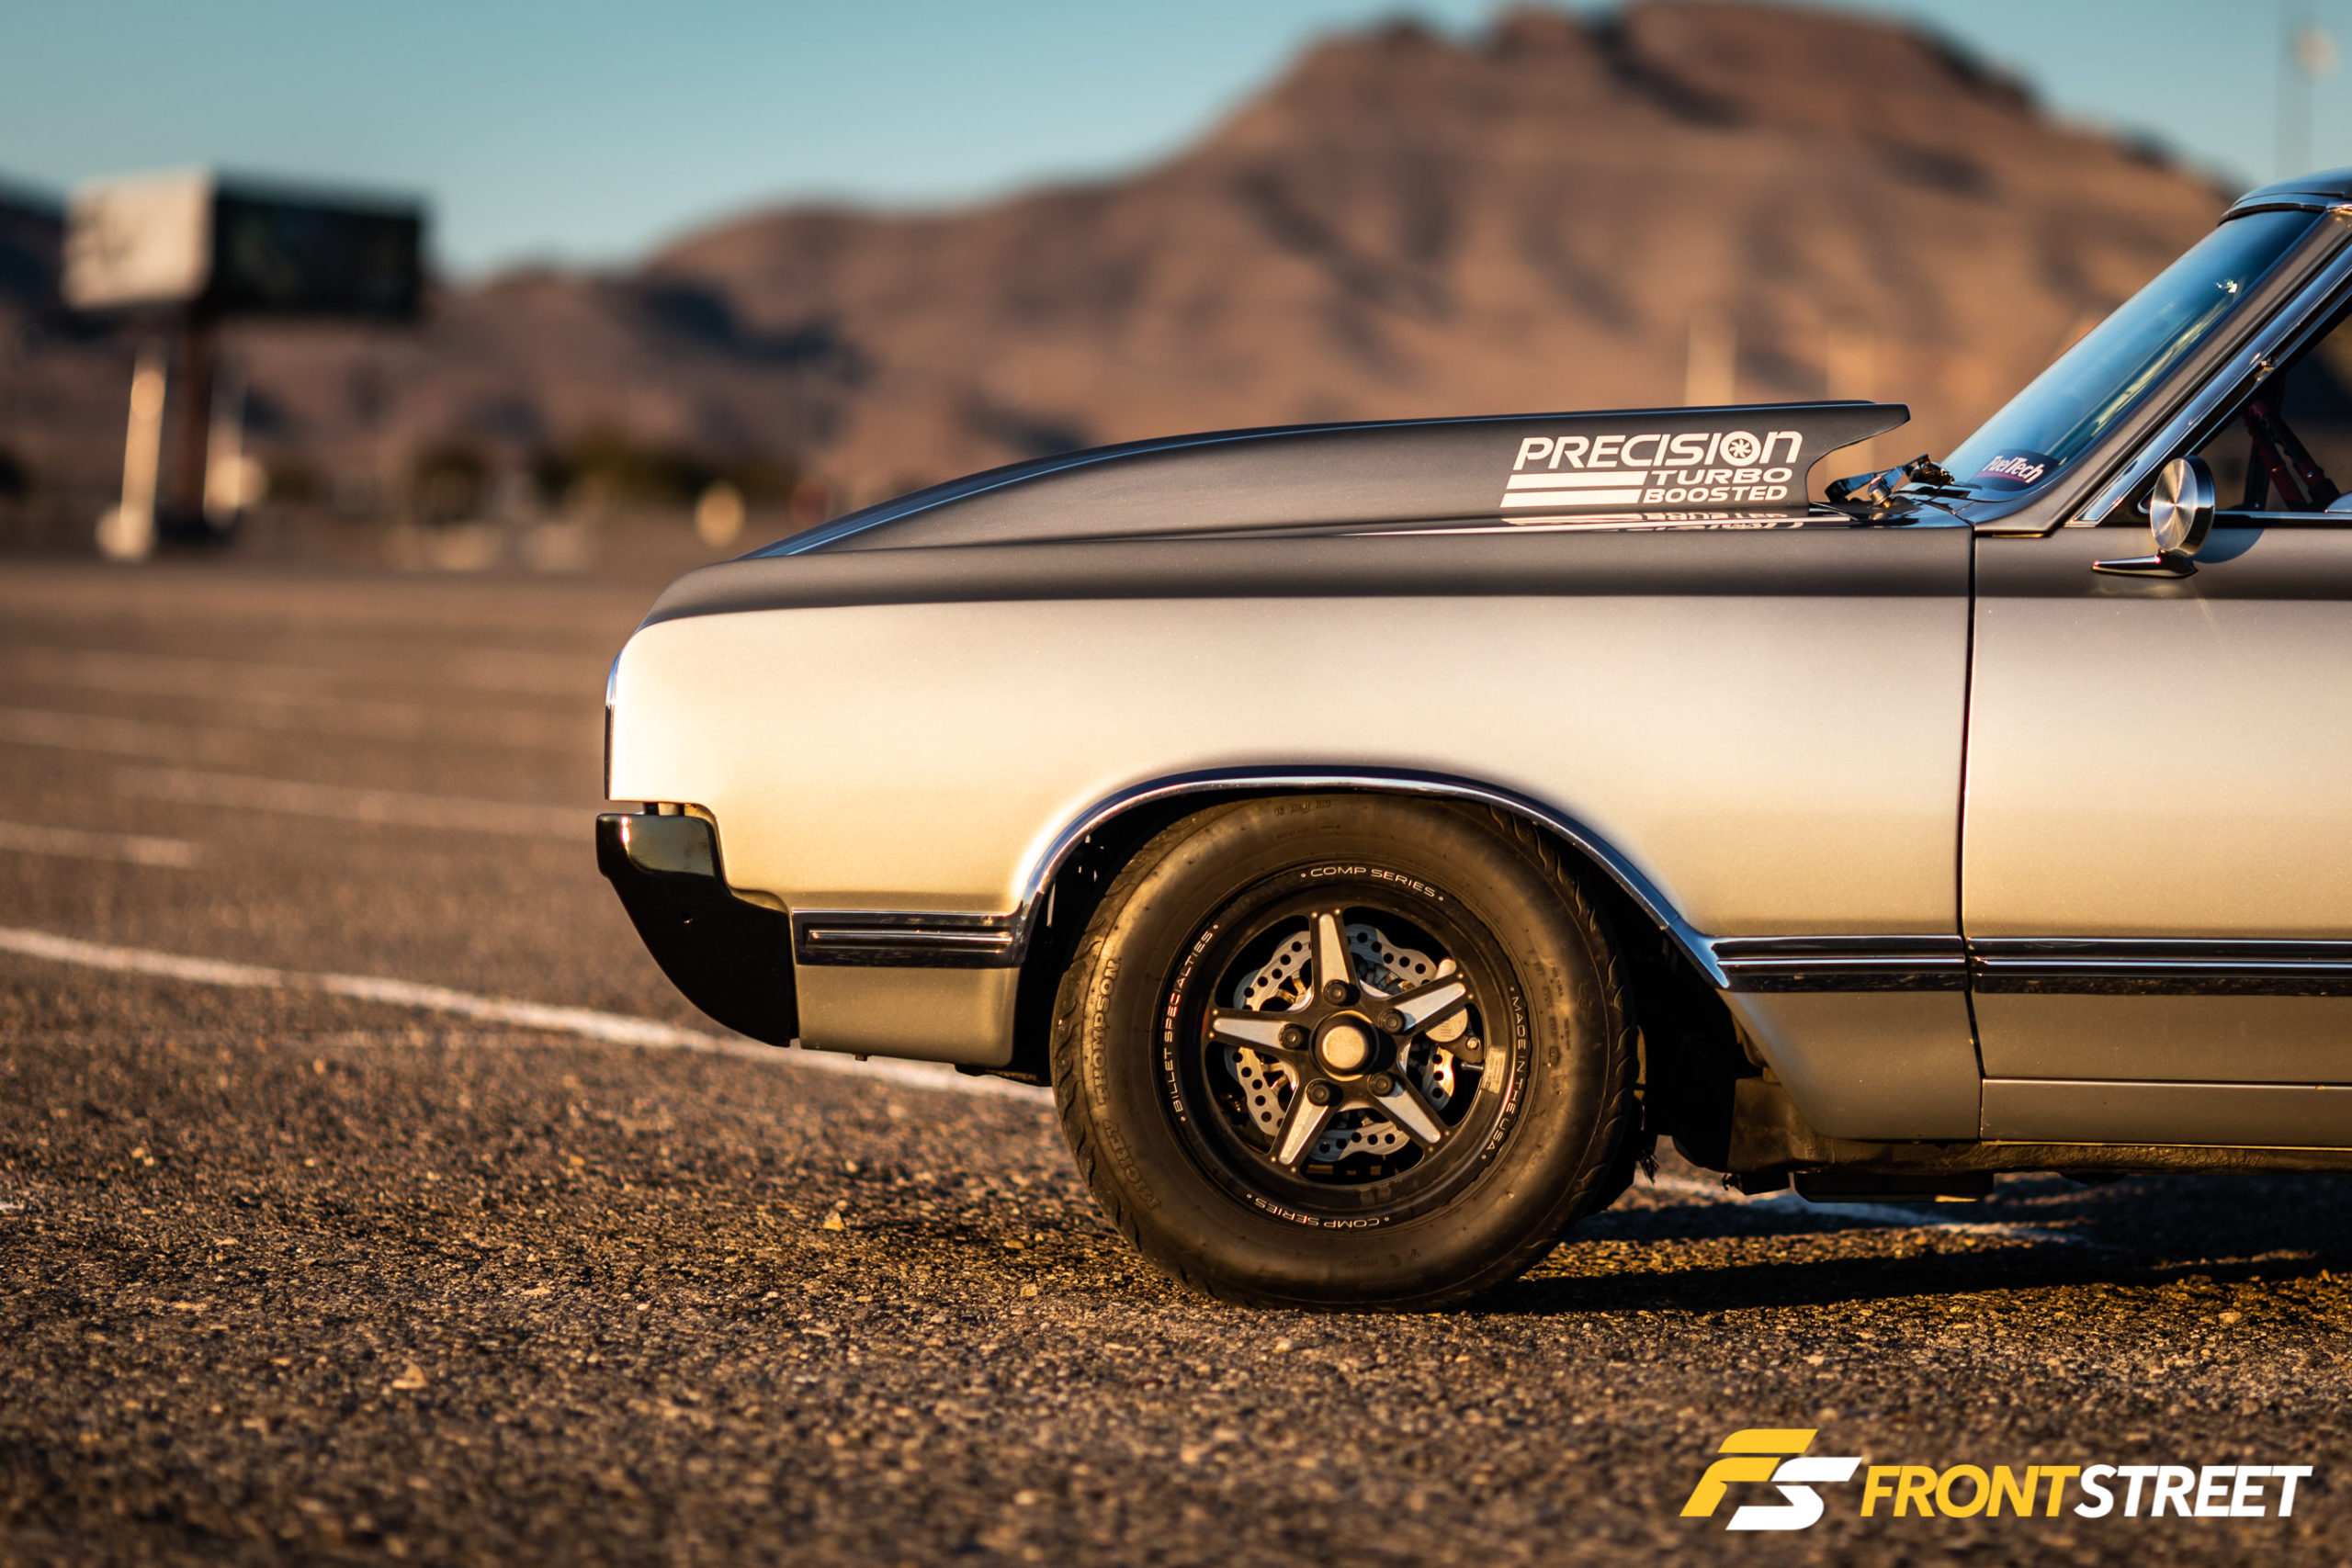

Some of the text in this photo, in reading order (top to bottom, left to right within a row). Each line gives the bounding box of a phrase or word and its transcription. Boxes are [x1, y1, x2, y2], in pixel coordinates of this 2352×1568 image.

[1651, 468, 1792, 486] TURBO
[1982, 456, 2044, 484] FuelTech
[1643, 485, 1788, 504] BOOSTED
[1310, 866, 1435, 897] COMP SERIES
[1091, 959, 1121, 1105] THOMPSON
[1163, 931, 1214, 1112] BILLET SPECIALTIES
[1487, 996, 1526, 1151] MADE IN THE USA
[1254, 1197, 1380, 1229] COMP SERIES
